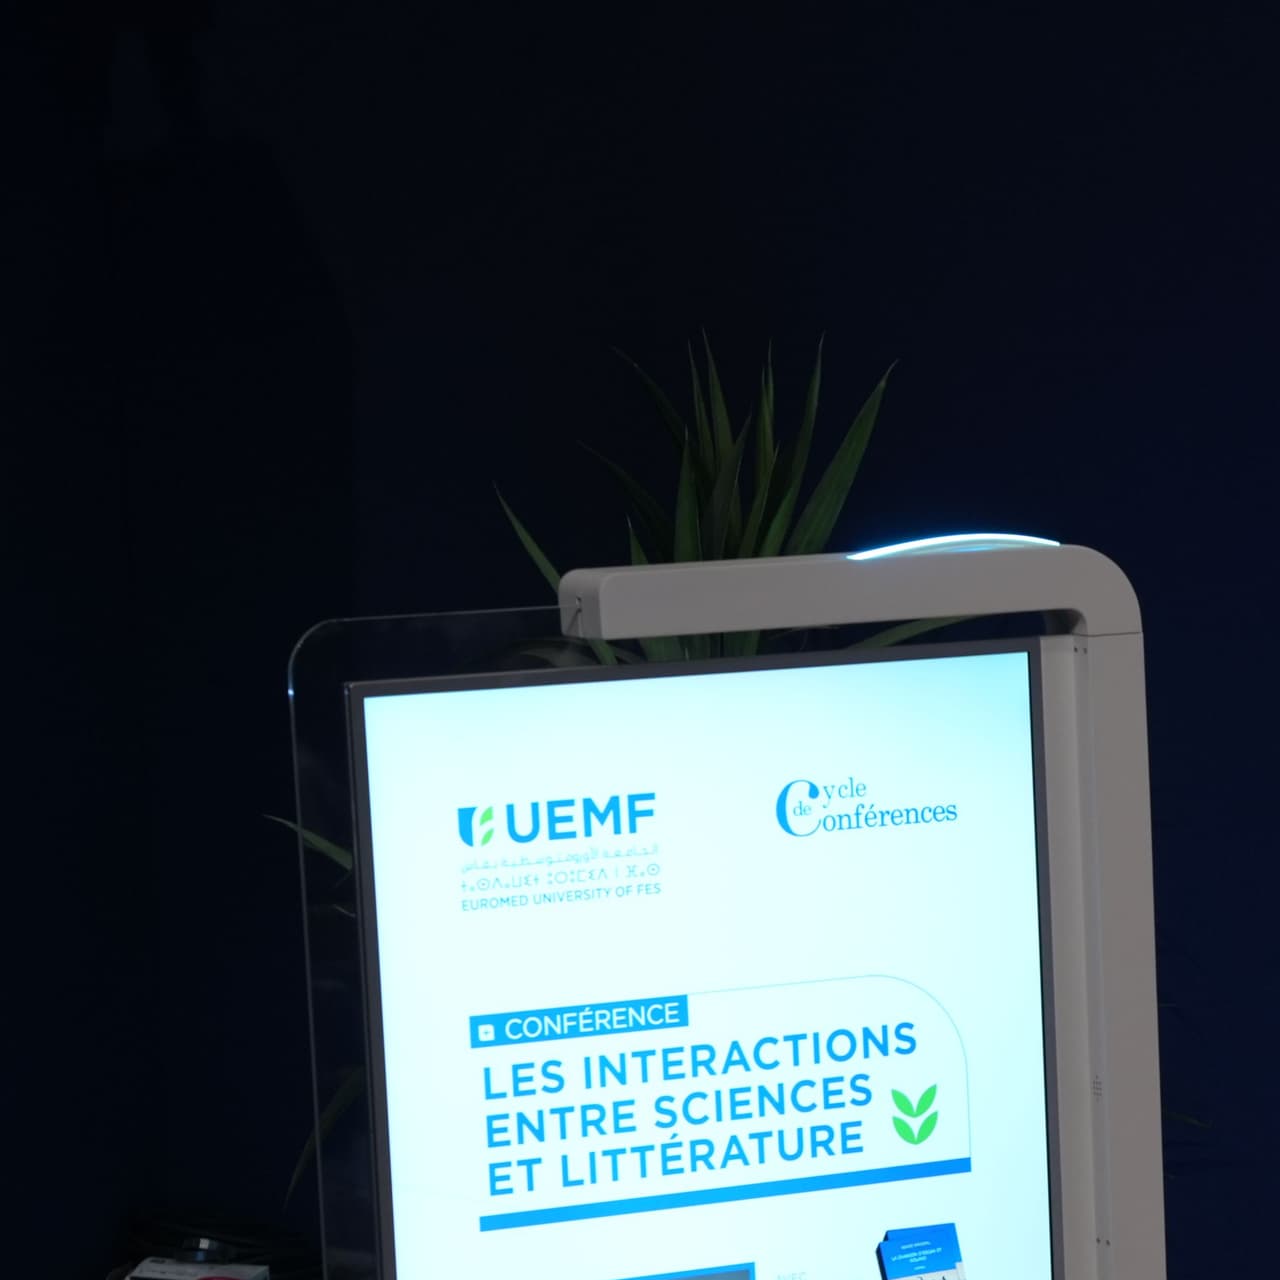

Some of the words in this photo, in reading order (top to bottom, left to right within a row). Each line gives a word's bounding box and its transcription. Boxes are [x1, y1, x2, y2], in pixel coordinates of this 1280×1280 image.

[506, 792, 656, 844] UEMF
[793, 800, 812, 817] de
[462, 894, 529, 912] EUROMED
[533, 887, 611, 905] UNIVERSITY
[616, 884, 633, 898] OF
[637, 882, 662, 896] FES
[505, 1002, 680, 1040] CONFÉRENCE
[484, 1059, 564, 1100] LES
[584, 1022, 917, 1090] INTERACTIONS
[486, 1100, 636, 1148] ENTRE
[654, 1073, 873, 1129] SCIENCES
[489, 1158, 542, 1196] ET
[562, 1120, 864, 1187] LITTÉRATURE
